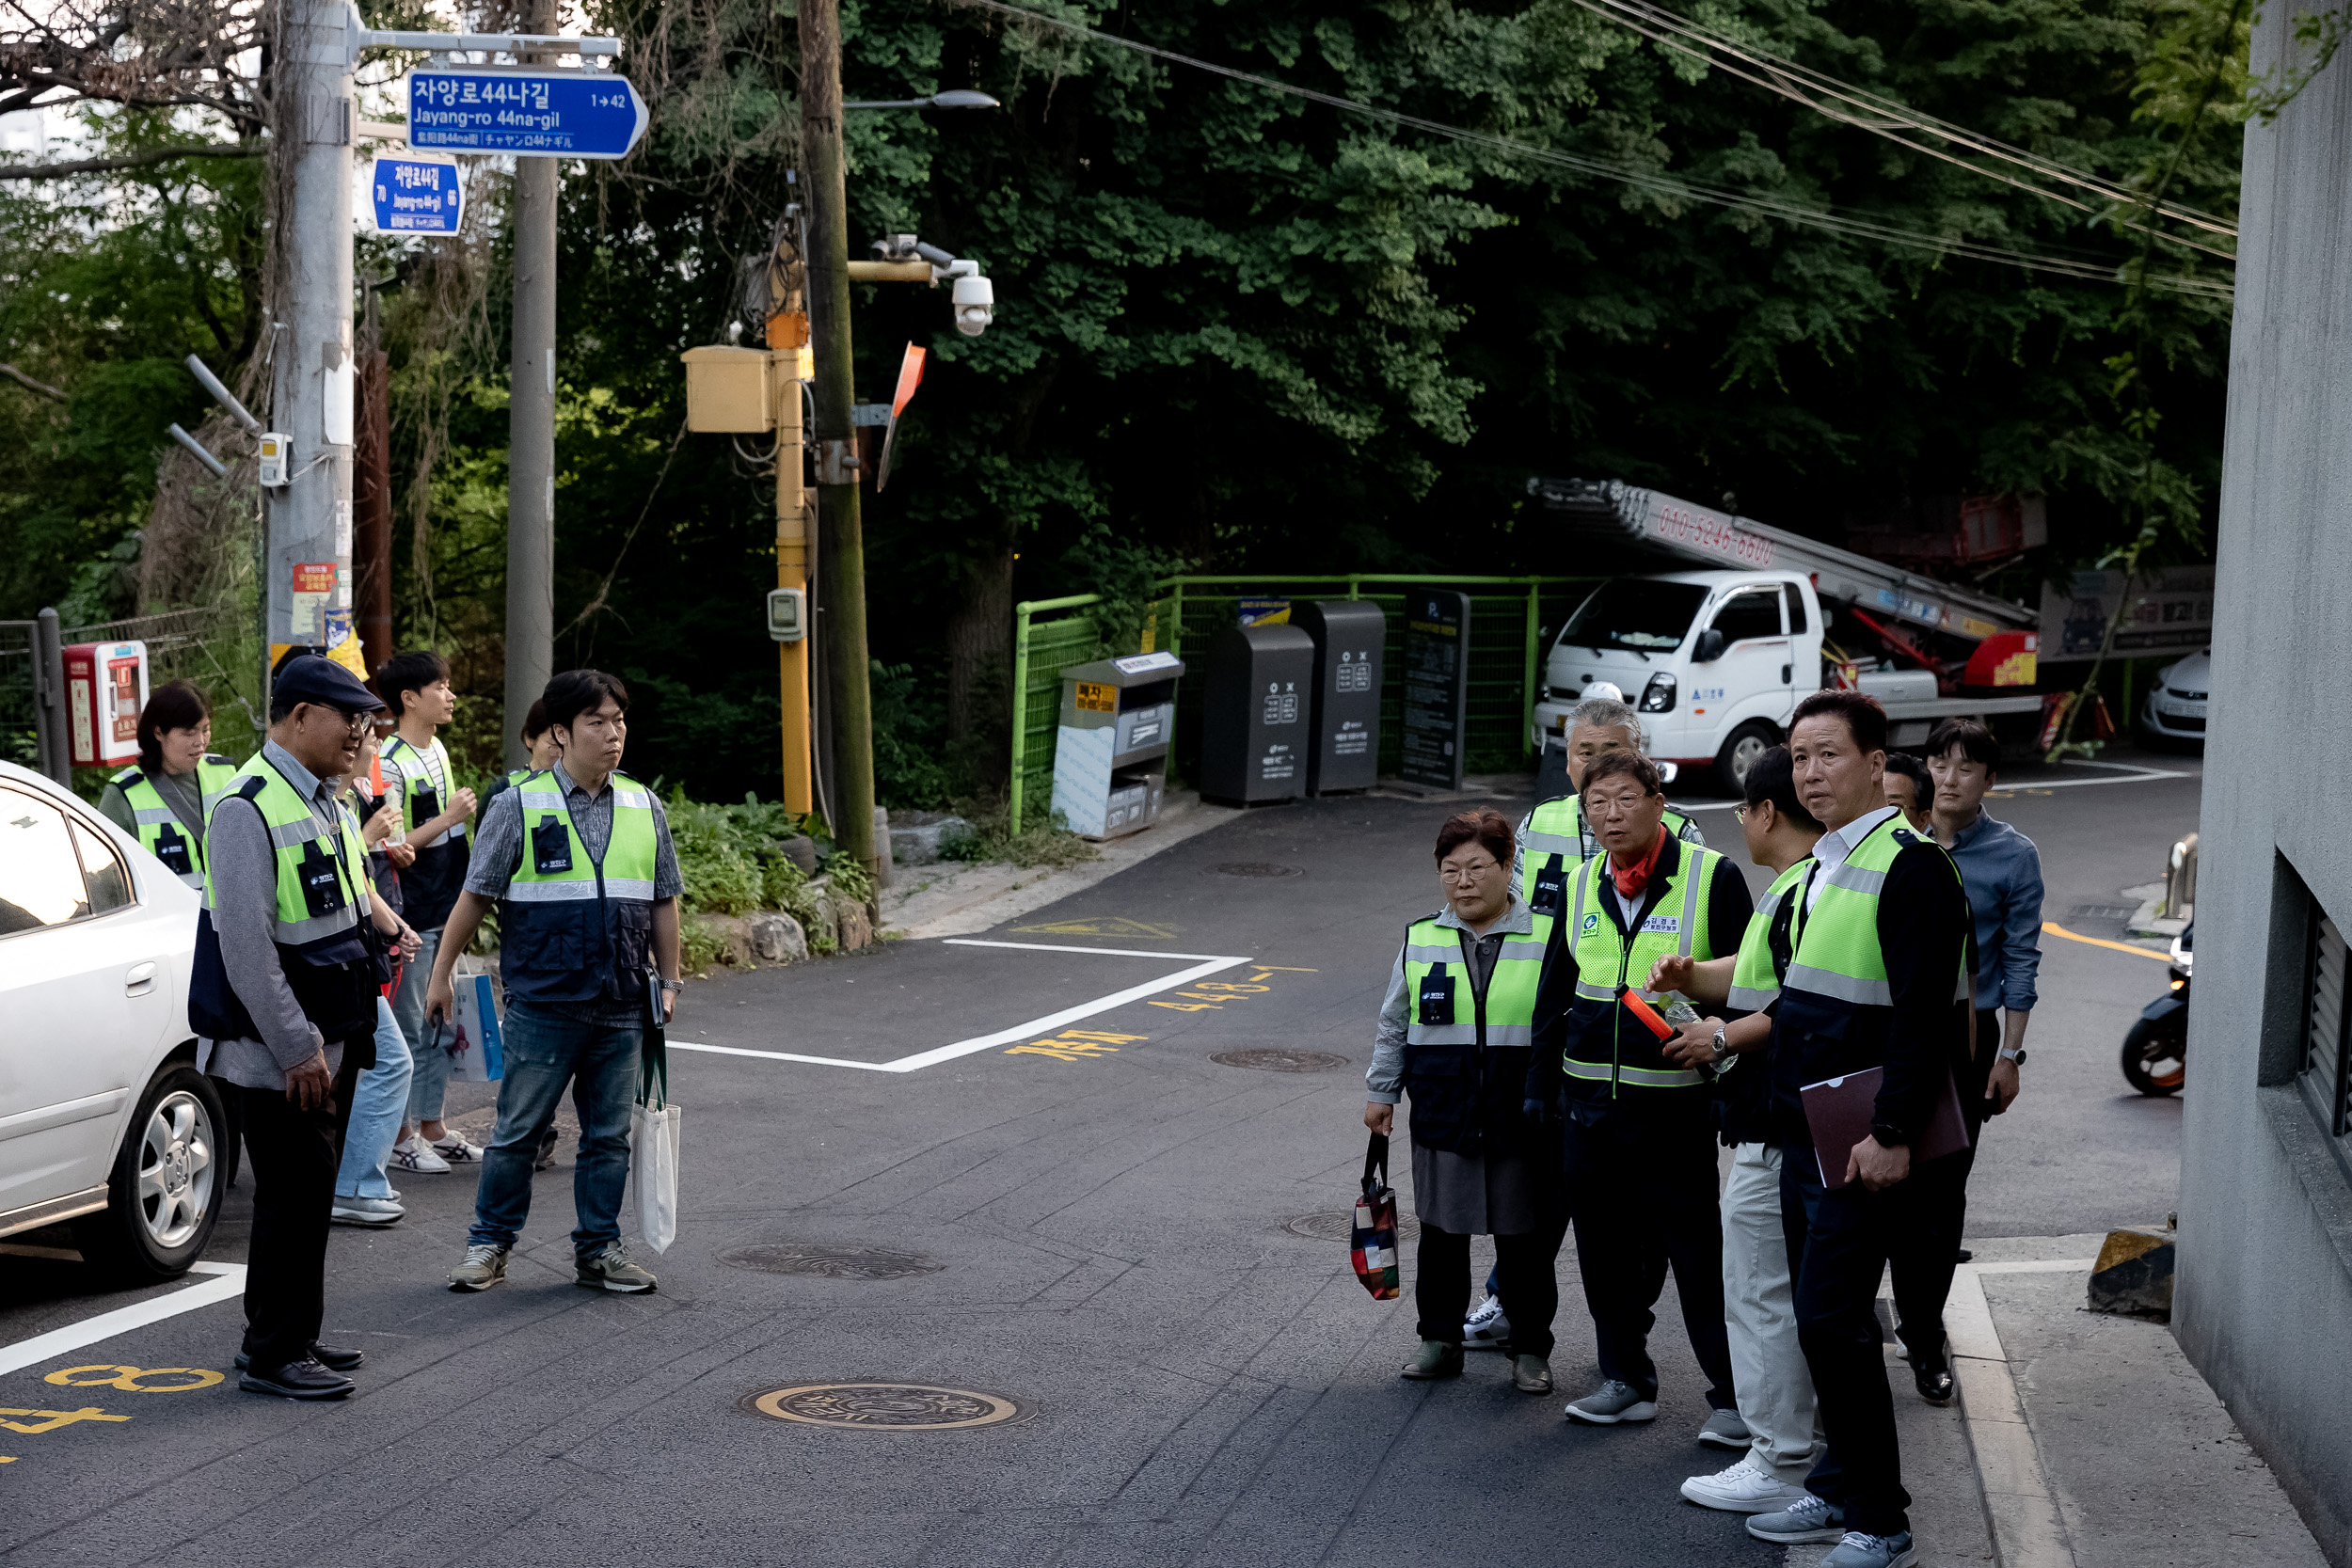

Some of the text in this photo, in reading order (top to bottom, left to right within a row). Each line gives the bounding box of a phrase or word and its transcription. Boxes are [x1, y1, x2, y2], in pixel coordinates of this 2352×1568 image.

[415, 79, 549, 109] 자양로44나길
[414, 107, 560, 130] Jayang-ro 44na-gil
[1658, 504, 1774, 566] 010-5246-6600
[1147, 965, 1318, 1011] 448-1
